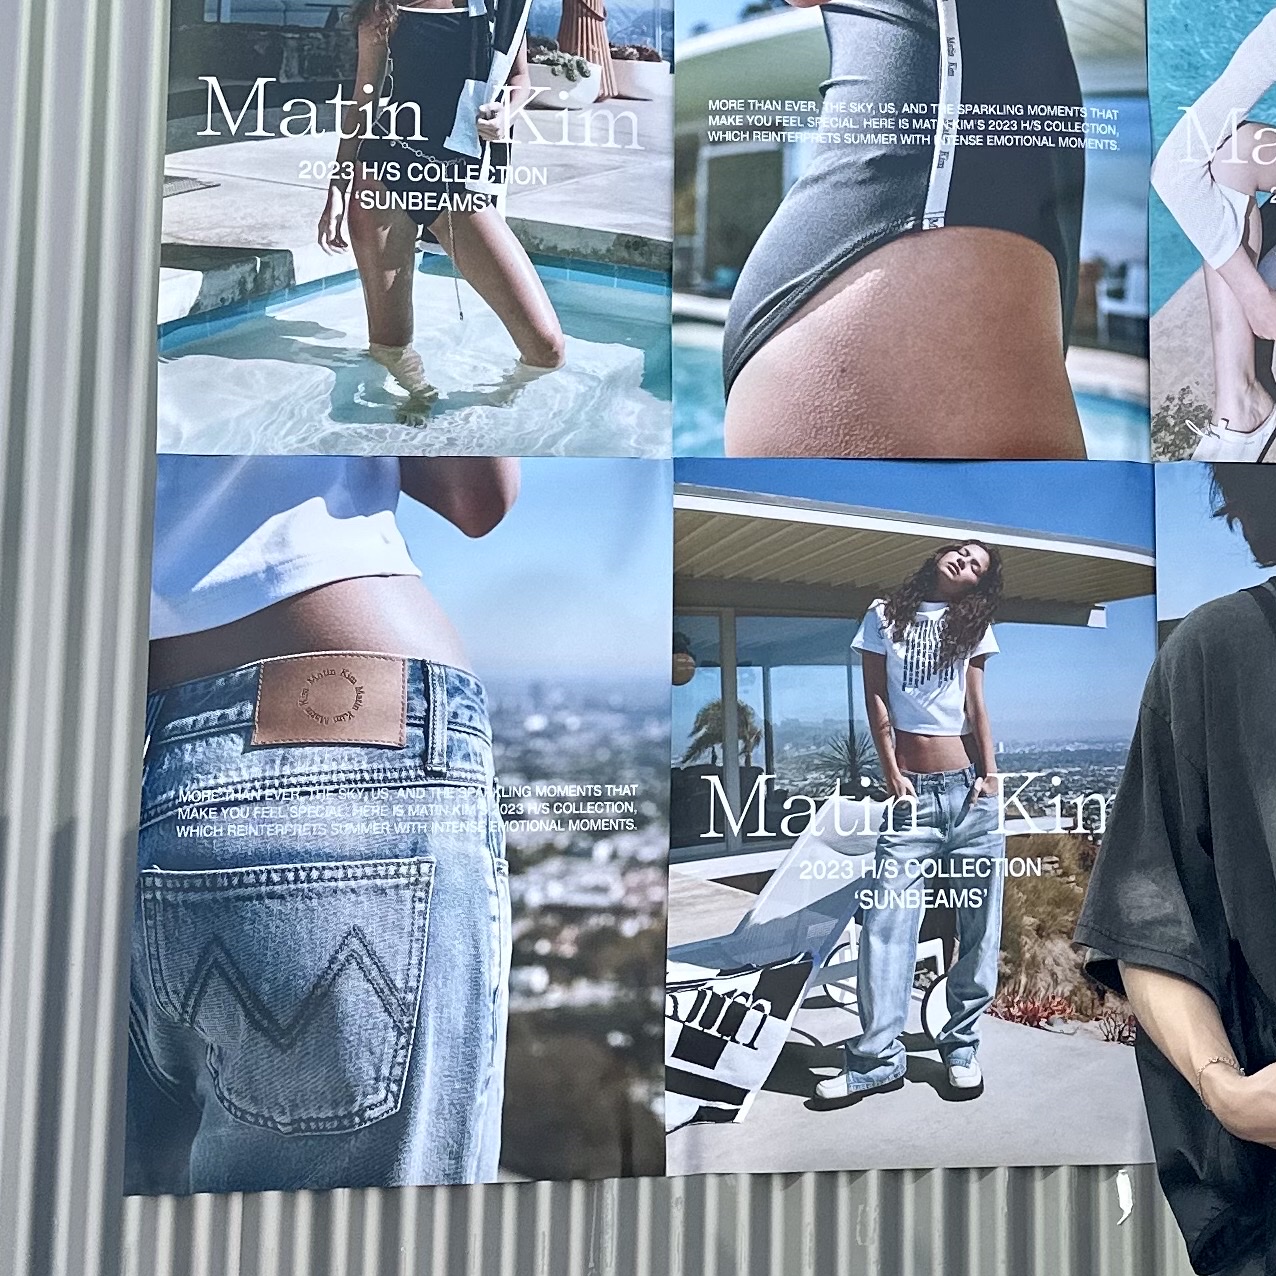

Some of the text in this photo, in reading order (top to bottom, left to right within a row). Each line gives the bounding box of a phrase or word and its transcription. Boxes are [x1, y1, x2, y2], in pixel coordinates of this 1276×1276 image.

[196, 76, 645, 150] Matin Kim
[708, 100, 745, 111] MORE
[748, 100, 782, 111] THAN
[784, 101, 819, 114] EVER,
[823, 102, 846, 113] THE
[849, 103, 876, 116] SKY,
[879, 103, 898, 116] US,
[902, 103, 928, 114] AND
[957, 104, 1024, 116] SPARKLING
[1028, 105, 1087, 117] MOMENTS
[1090, 107, 1119, 120] THAT
[708, 115, 743, 126] MAKE
[746, 115, 772, 126] YOU
[775, 116, 804, 127] FEEL
[863, 118, 896, 129] HERE
[899, 119, 909, 129] IS
[988, 120, 1018, 131] 2023
[1021, 121, 1042, 131] H/S
[1044, 121, 1120, 137] COLLECTION,
[708, 131, 750, 142] WHICH
[752, 131, 841, 144] REINTERPRETS
[843, 133, 898, 145] SUMMER
[900, 134, 931, 146] WITH
[986, 135, 1055, 148] EMOTIONAL
[1058, 137, 1120, 151] MOMENTS.
[298, 160, 548, 186] 2023 H/S COLLECTION
[397, 787, 426, 799] AND
[535, 784, 602, 797] MOMENTS
[605, 784, 639, 797] THAT
[178, 807, 219, 820] MAKE
[221, 807, 250, 819] YOU
[253, 806, 286, 819] FEEL
[392, 804, 404, 817] IS
[527, 802, 550, 815] H/S
[553, 801, 638, 816] COLLECTION,
[700, 774, 923, 838] Matin
[176, 824, 223, 838] WHICH
[393, 822, 428, 835] WITH
[568, 819, 638, 832] MOMENTS.
[799, 856, 1043, 881] 2023 H/S COLLECTION
